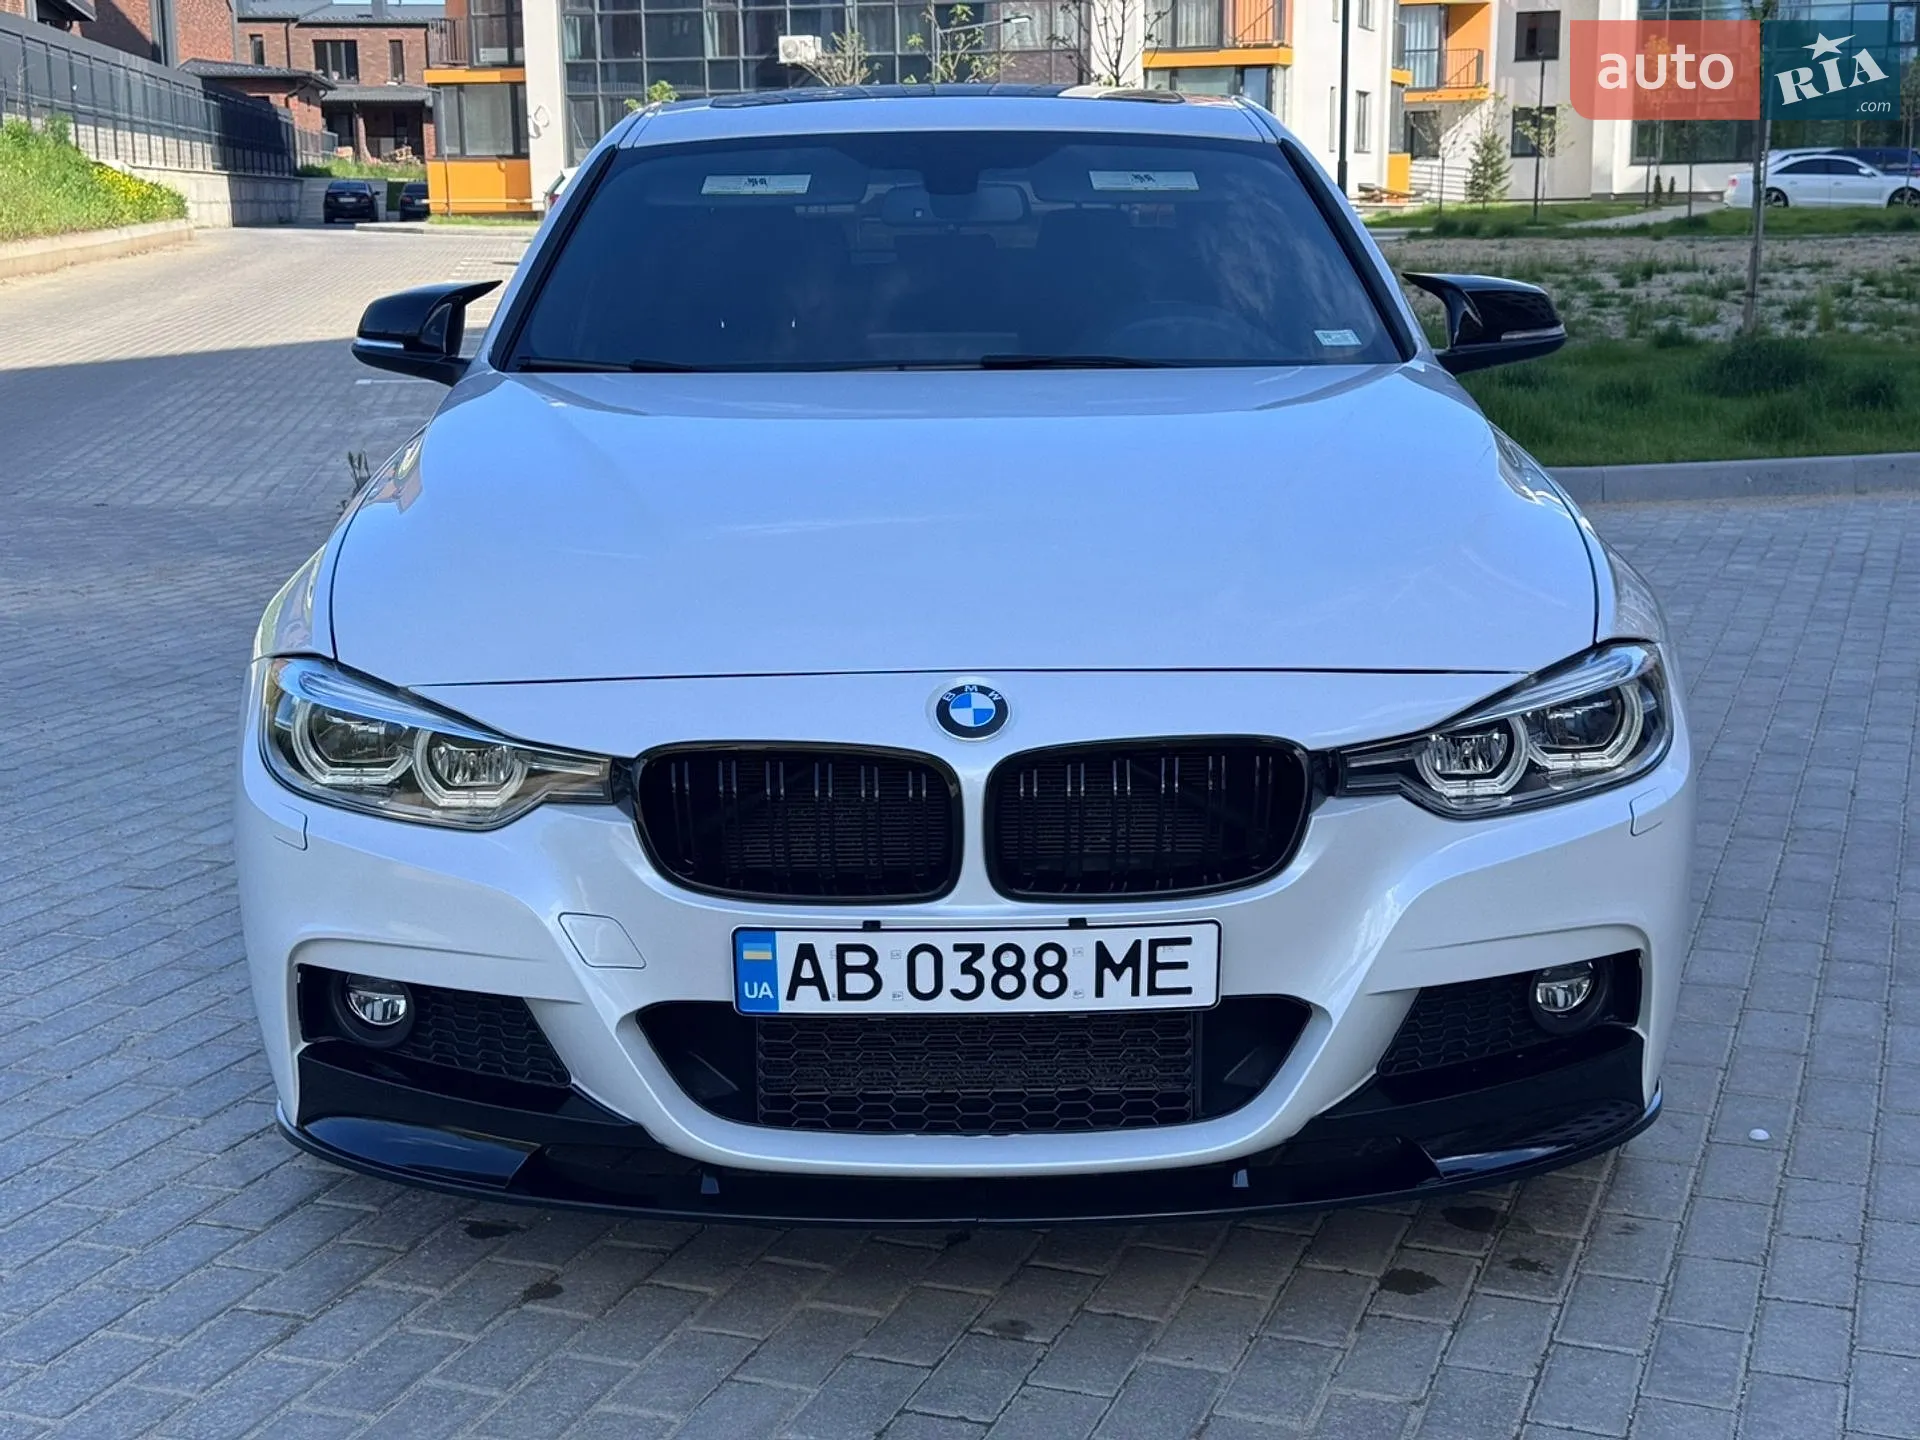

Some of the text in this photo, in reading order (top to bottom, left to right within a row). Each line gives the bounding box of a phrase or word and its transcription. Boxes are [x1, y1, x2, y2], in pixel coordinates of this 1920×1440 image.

[744, 980, 774, 999] UA
[785, 936, 1194, 1002] AB 0388 ME
